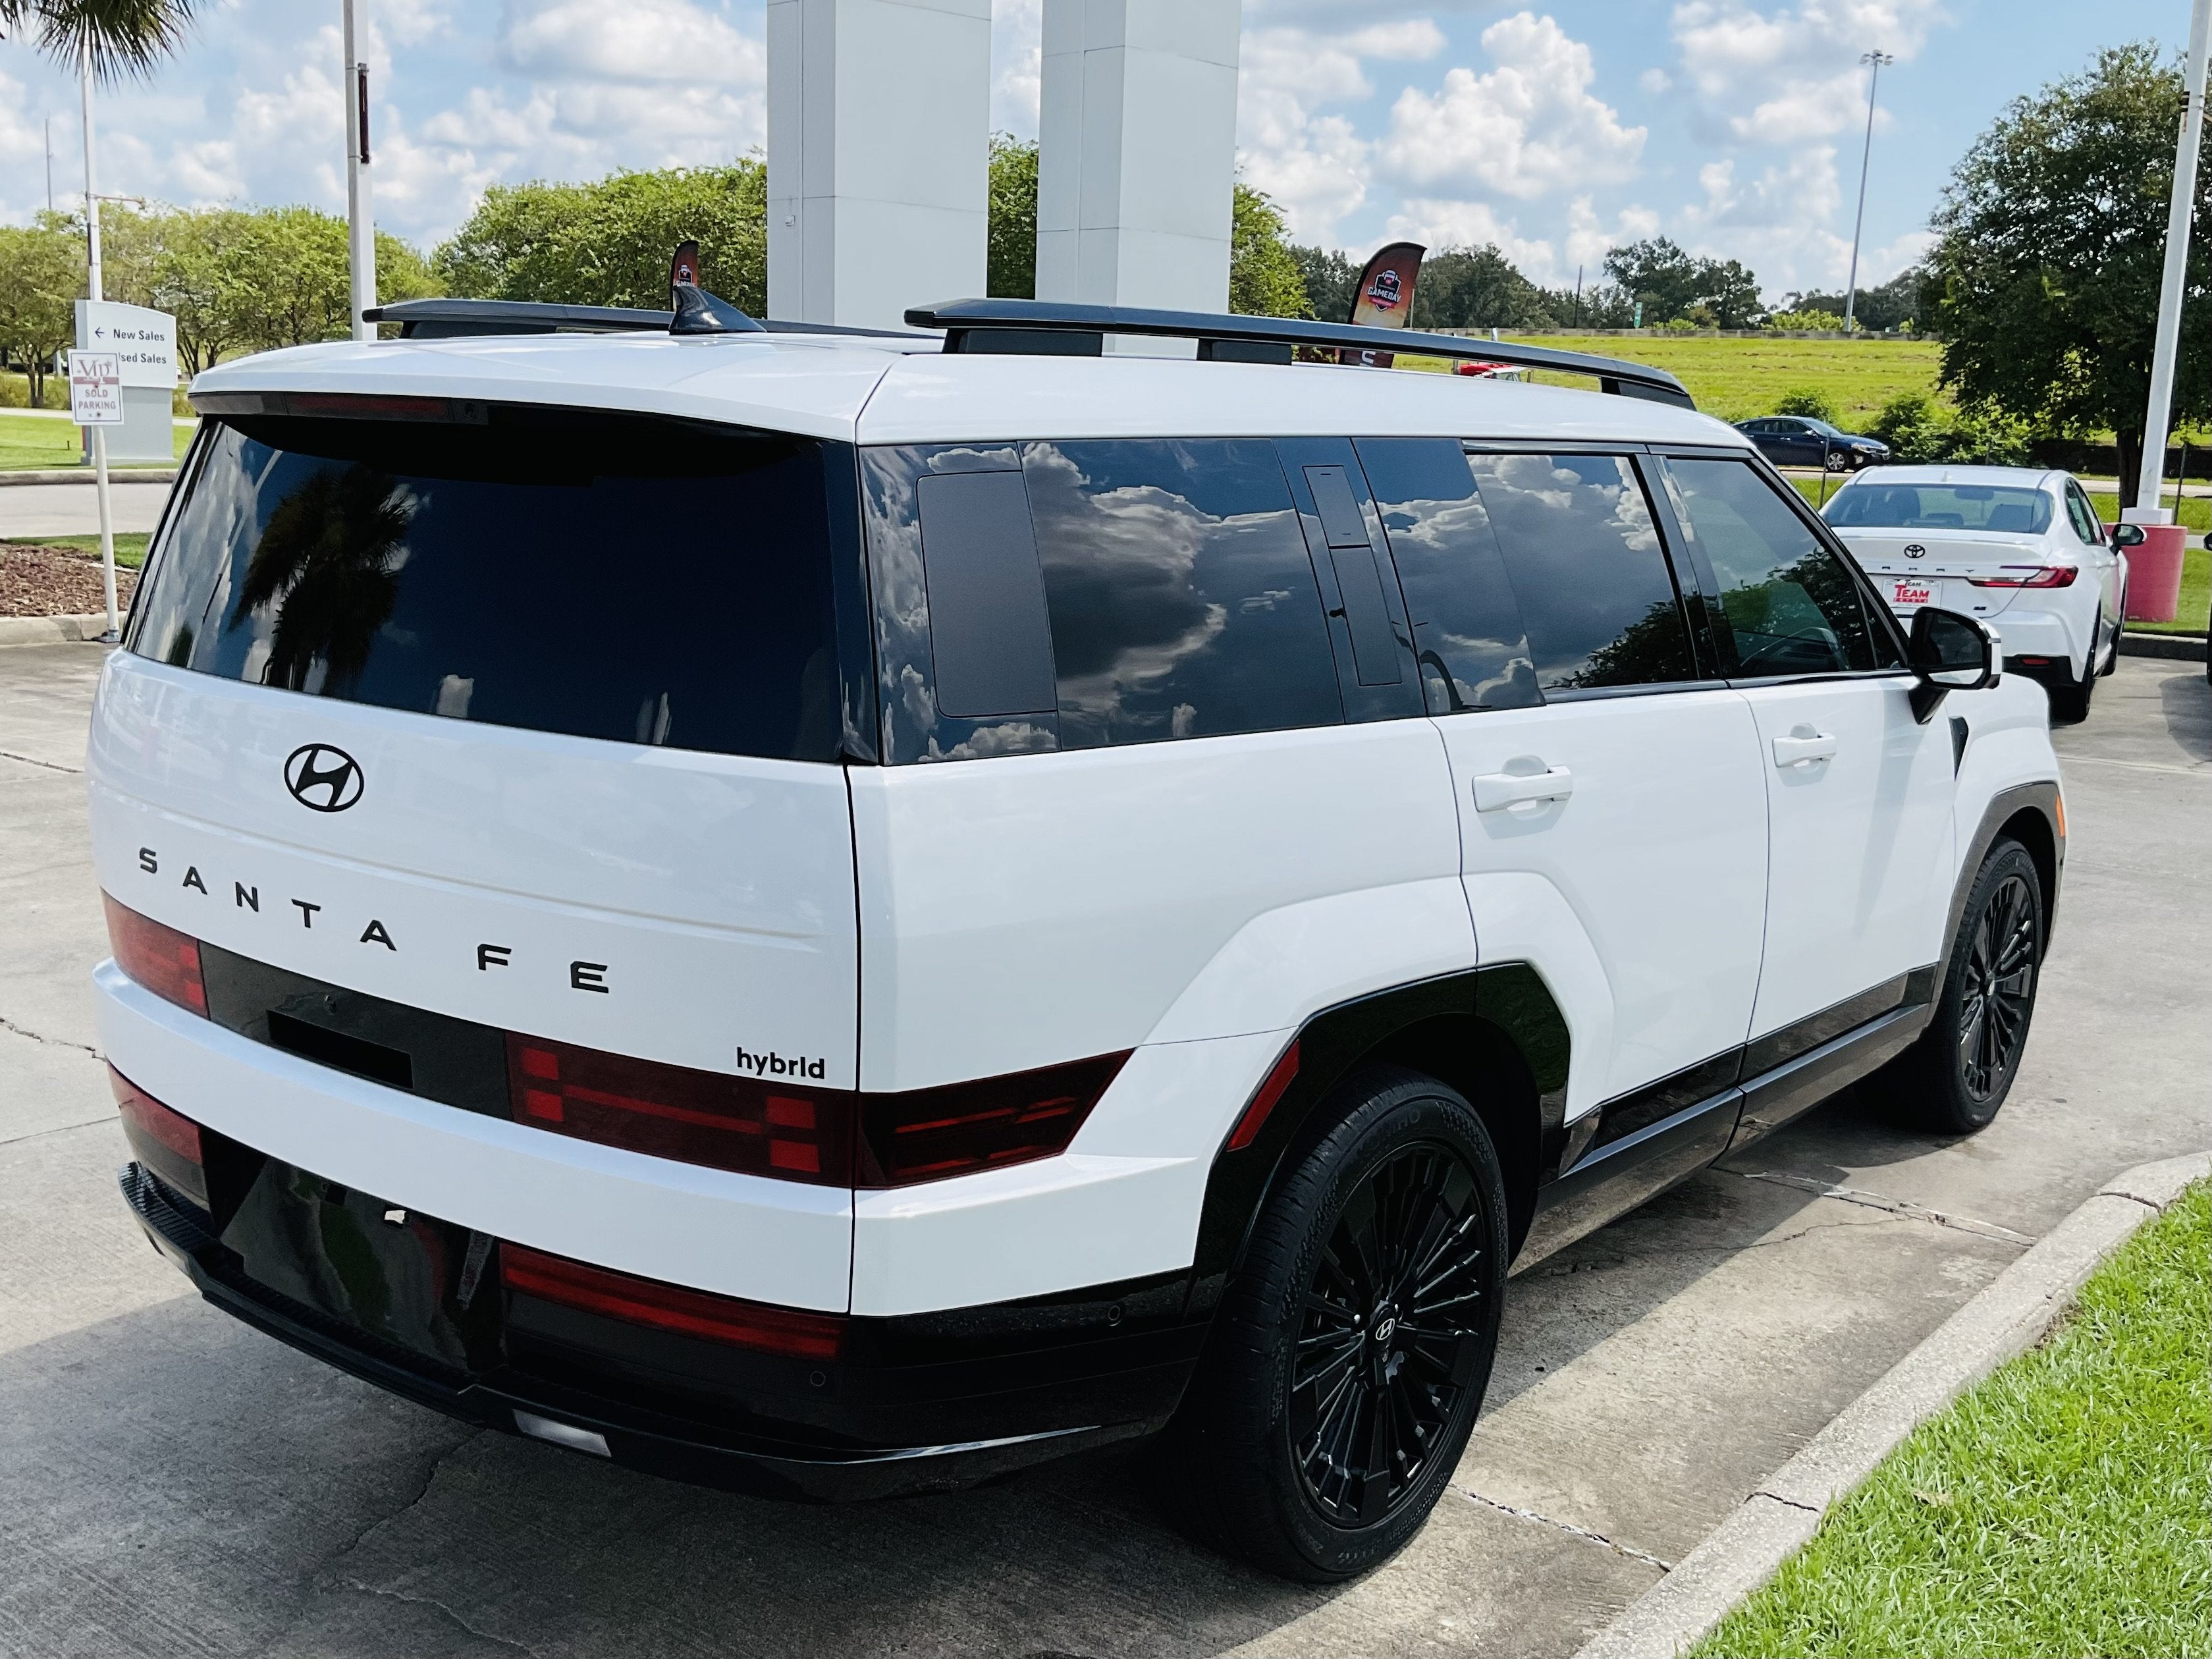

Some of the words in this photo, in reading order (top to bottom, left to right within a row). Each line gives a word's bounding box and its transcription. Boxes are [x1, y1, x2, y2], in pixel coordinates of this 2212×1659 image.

[1367, 286, 1402, 303] GAMEDAY
[113, 329, 136, 339] New
[138, 330, 165, 341] Sales
[119, 352, 138, 362] sed
[140, 353, 167, 364] Sales
[85, 389, 108, 398] SOLD
[78, 400, 116, 410] PARKING
[1895, 584, 1929, 597] TEAM
[139, 847, 397, 952] SANTA
[477, 943, 609, 994] FE
[736, 1047, 825, 1079] hybrid
